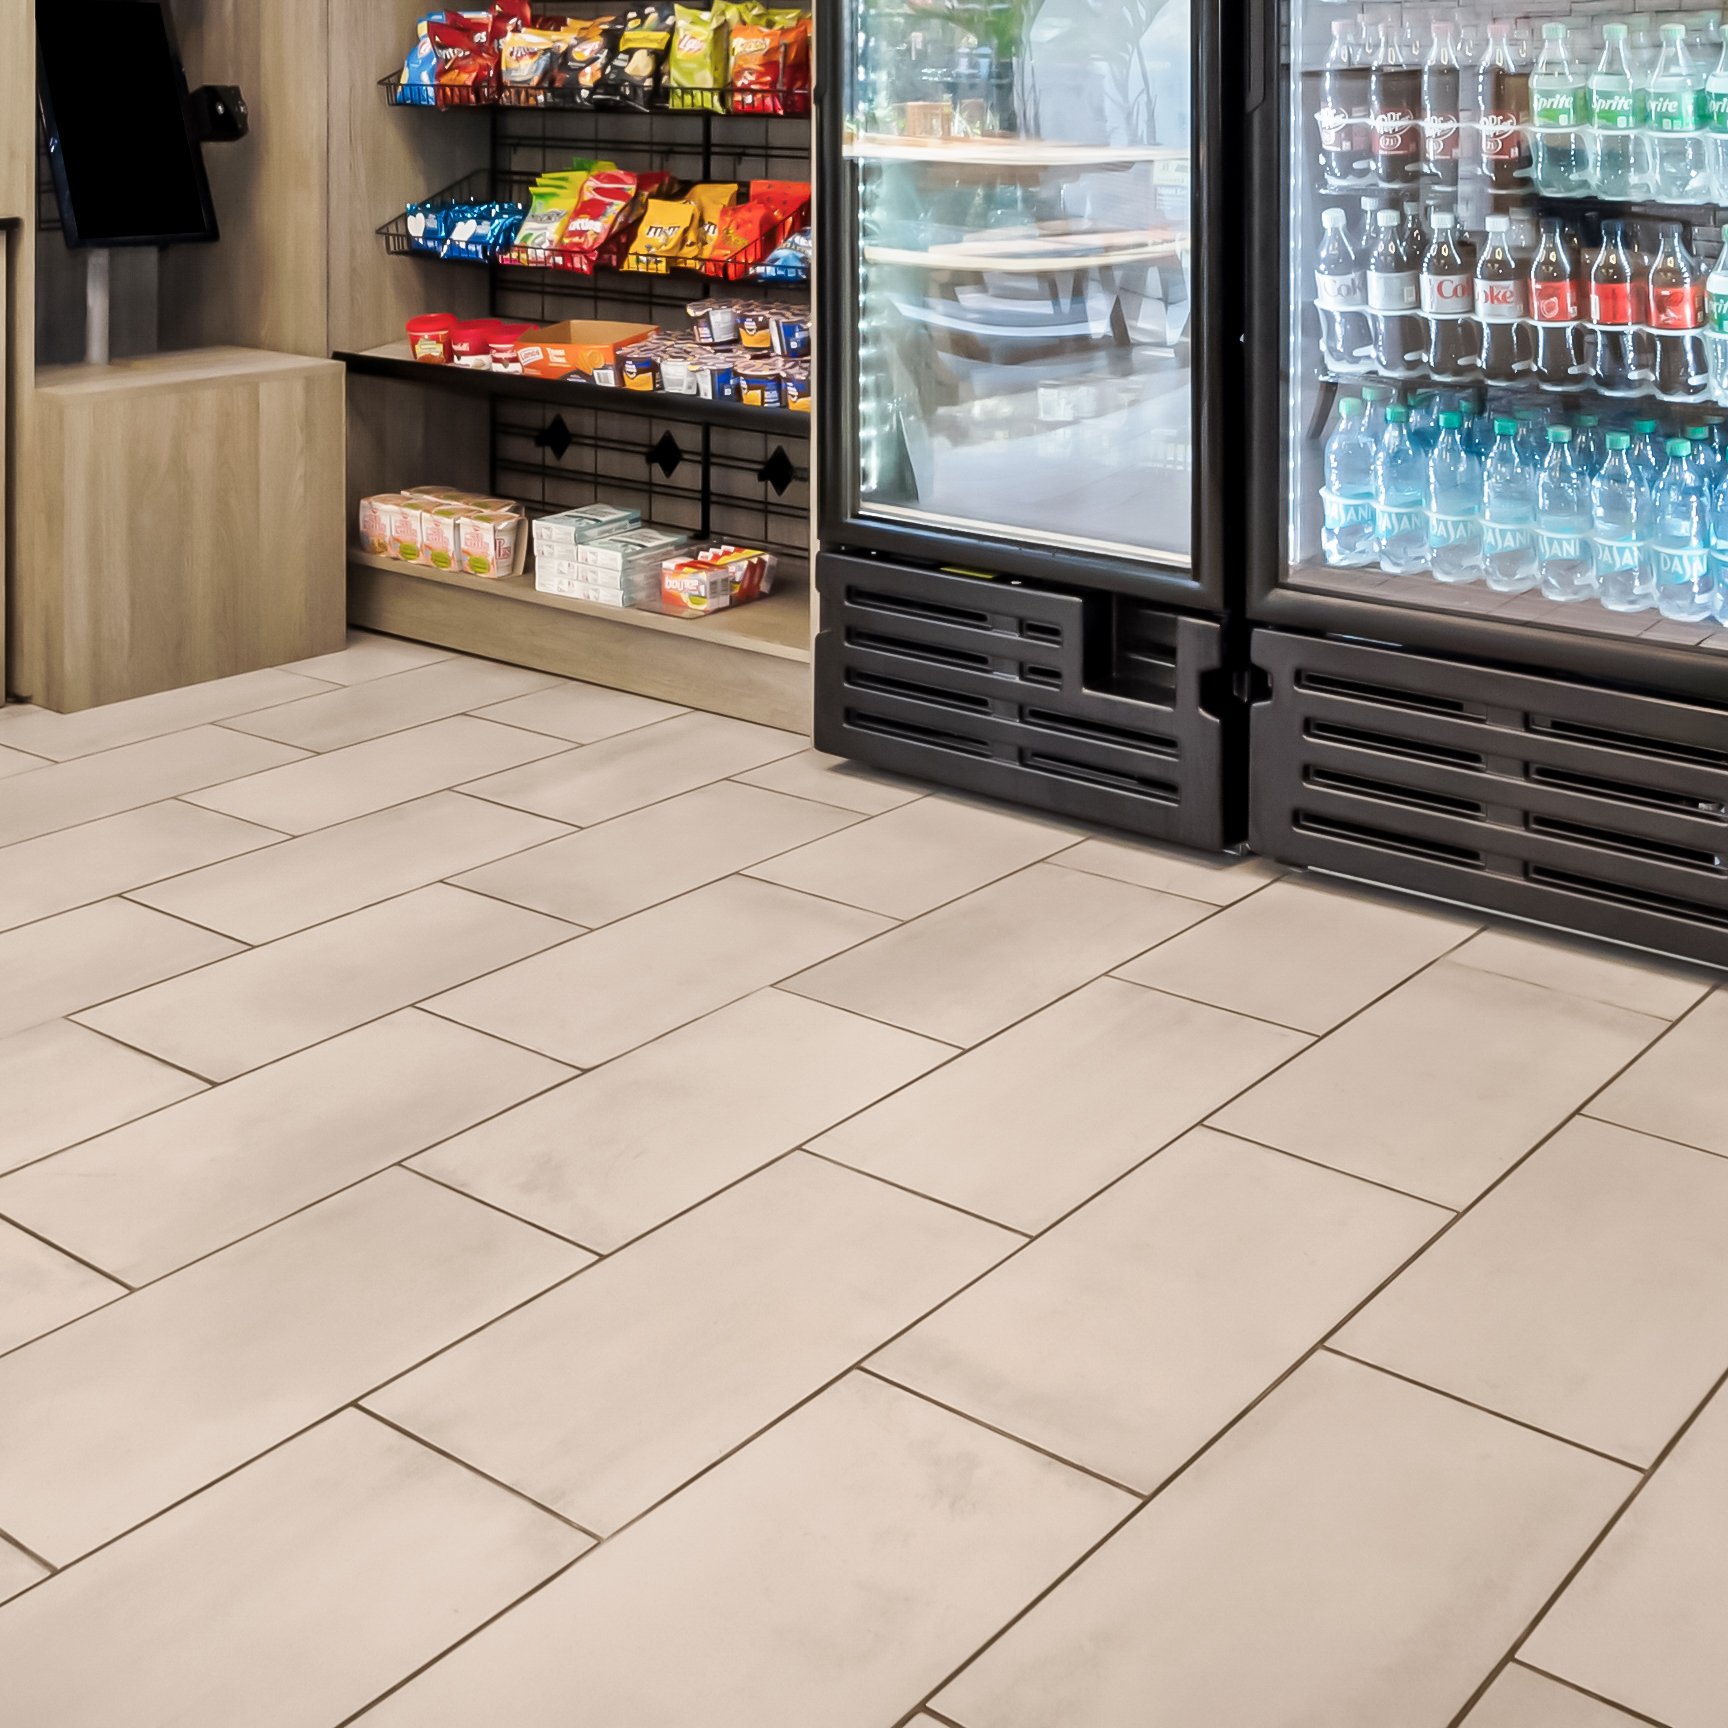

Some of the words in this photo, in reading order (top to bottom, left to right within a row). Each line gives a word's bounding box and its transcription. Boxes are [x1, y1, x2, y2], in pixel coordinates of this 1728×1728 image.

[1533, 93, 1574, 112] Sprite
[1592, 93, 1633, 113] Sprite
[1323, 275, 1362, 299] Cok
[1475, 284, 1515, 306] oke
